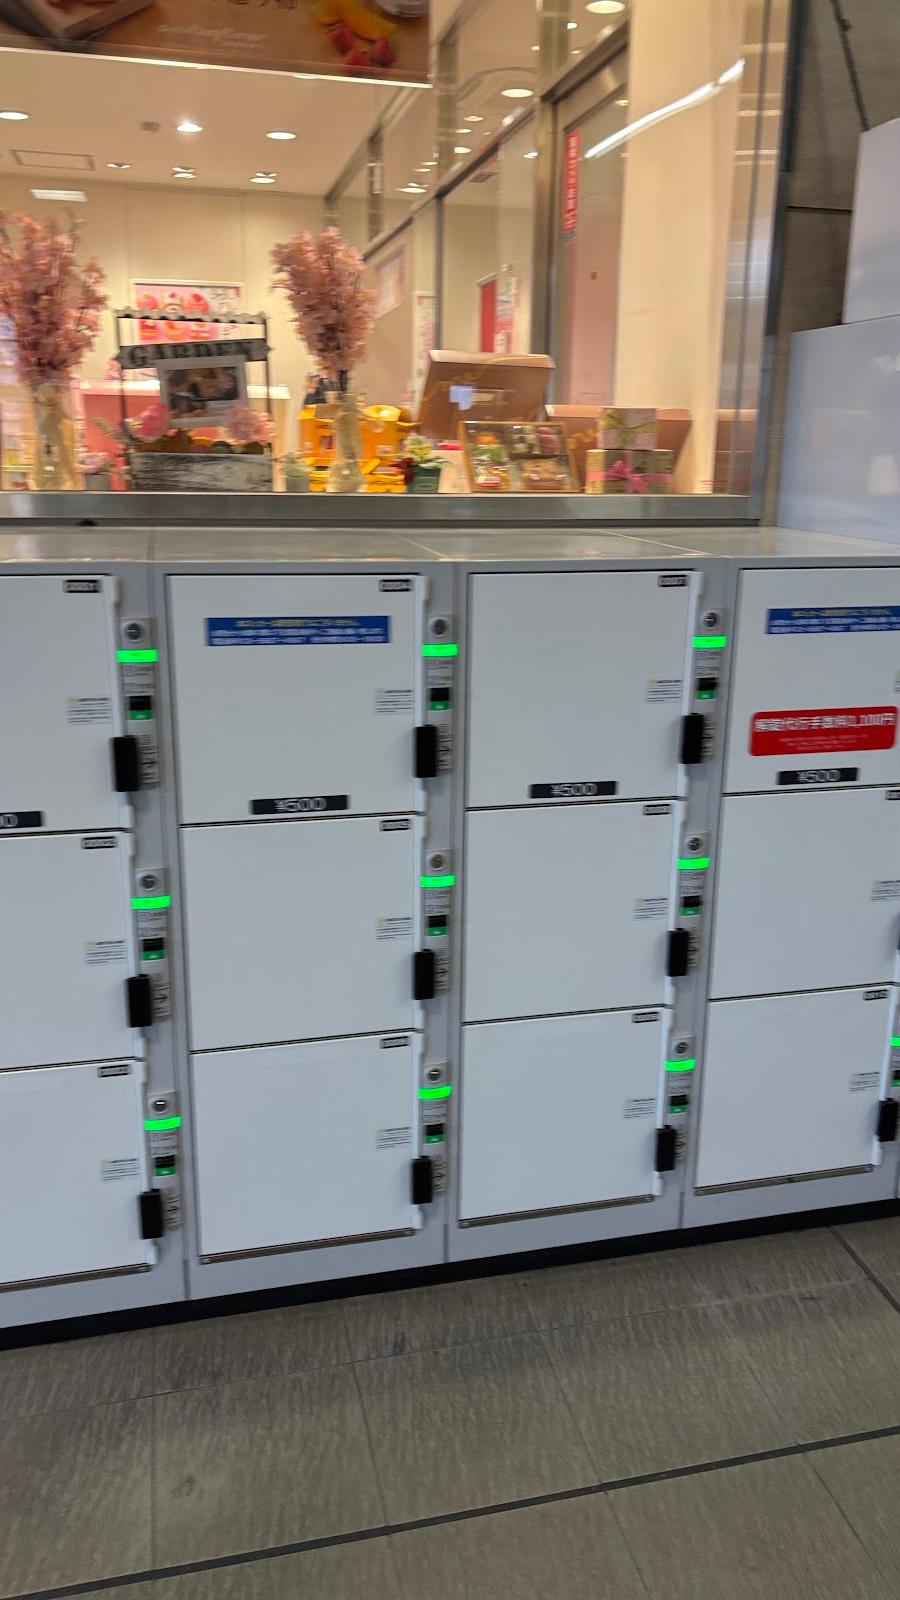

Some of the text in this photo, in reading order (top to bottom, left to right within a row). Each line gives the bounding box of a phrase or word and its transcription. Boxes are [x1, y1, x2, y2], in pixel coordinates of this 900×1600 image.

[799, 768, 840, 783] ¥500
[551, 783, 598, 797] ¥500
[273, 797, 327, 813] ¥500
